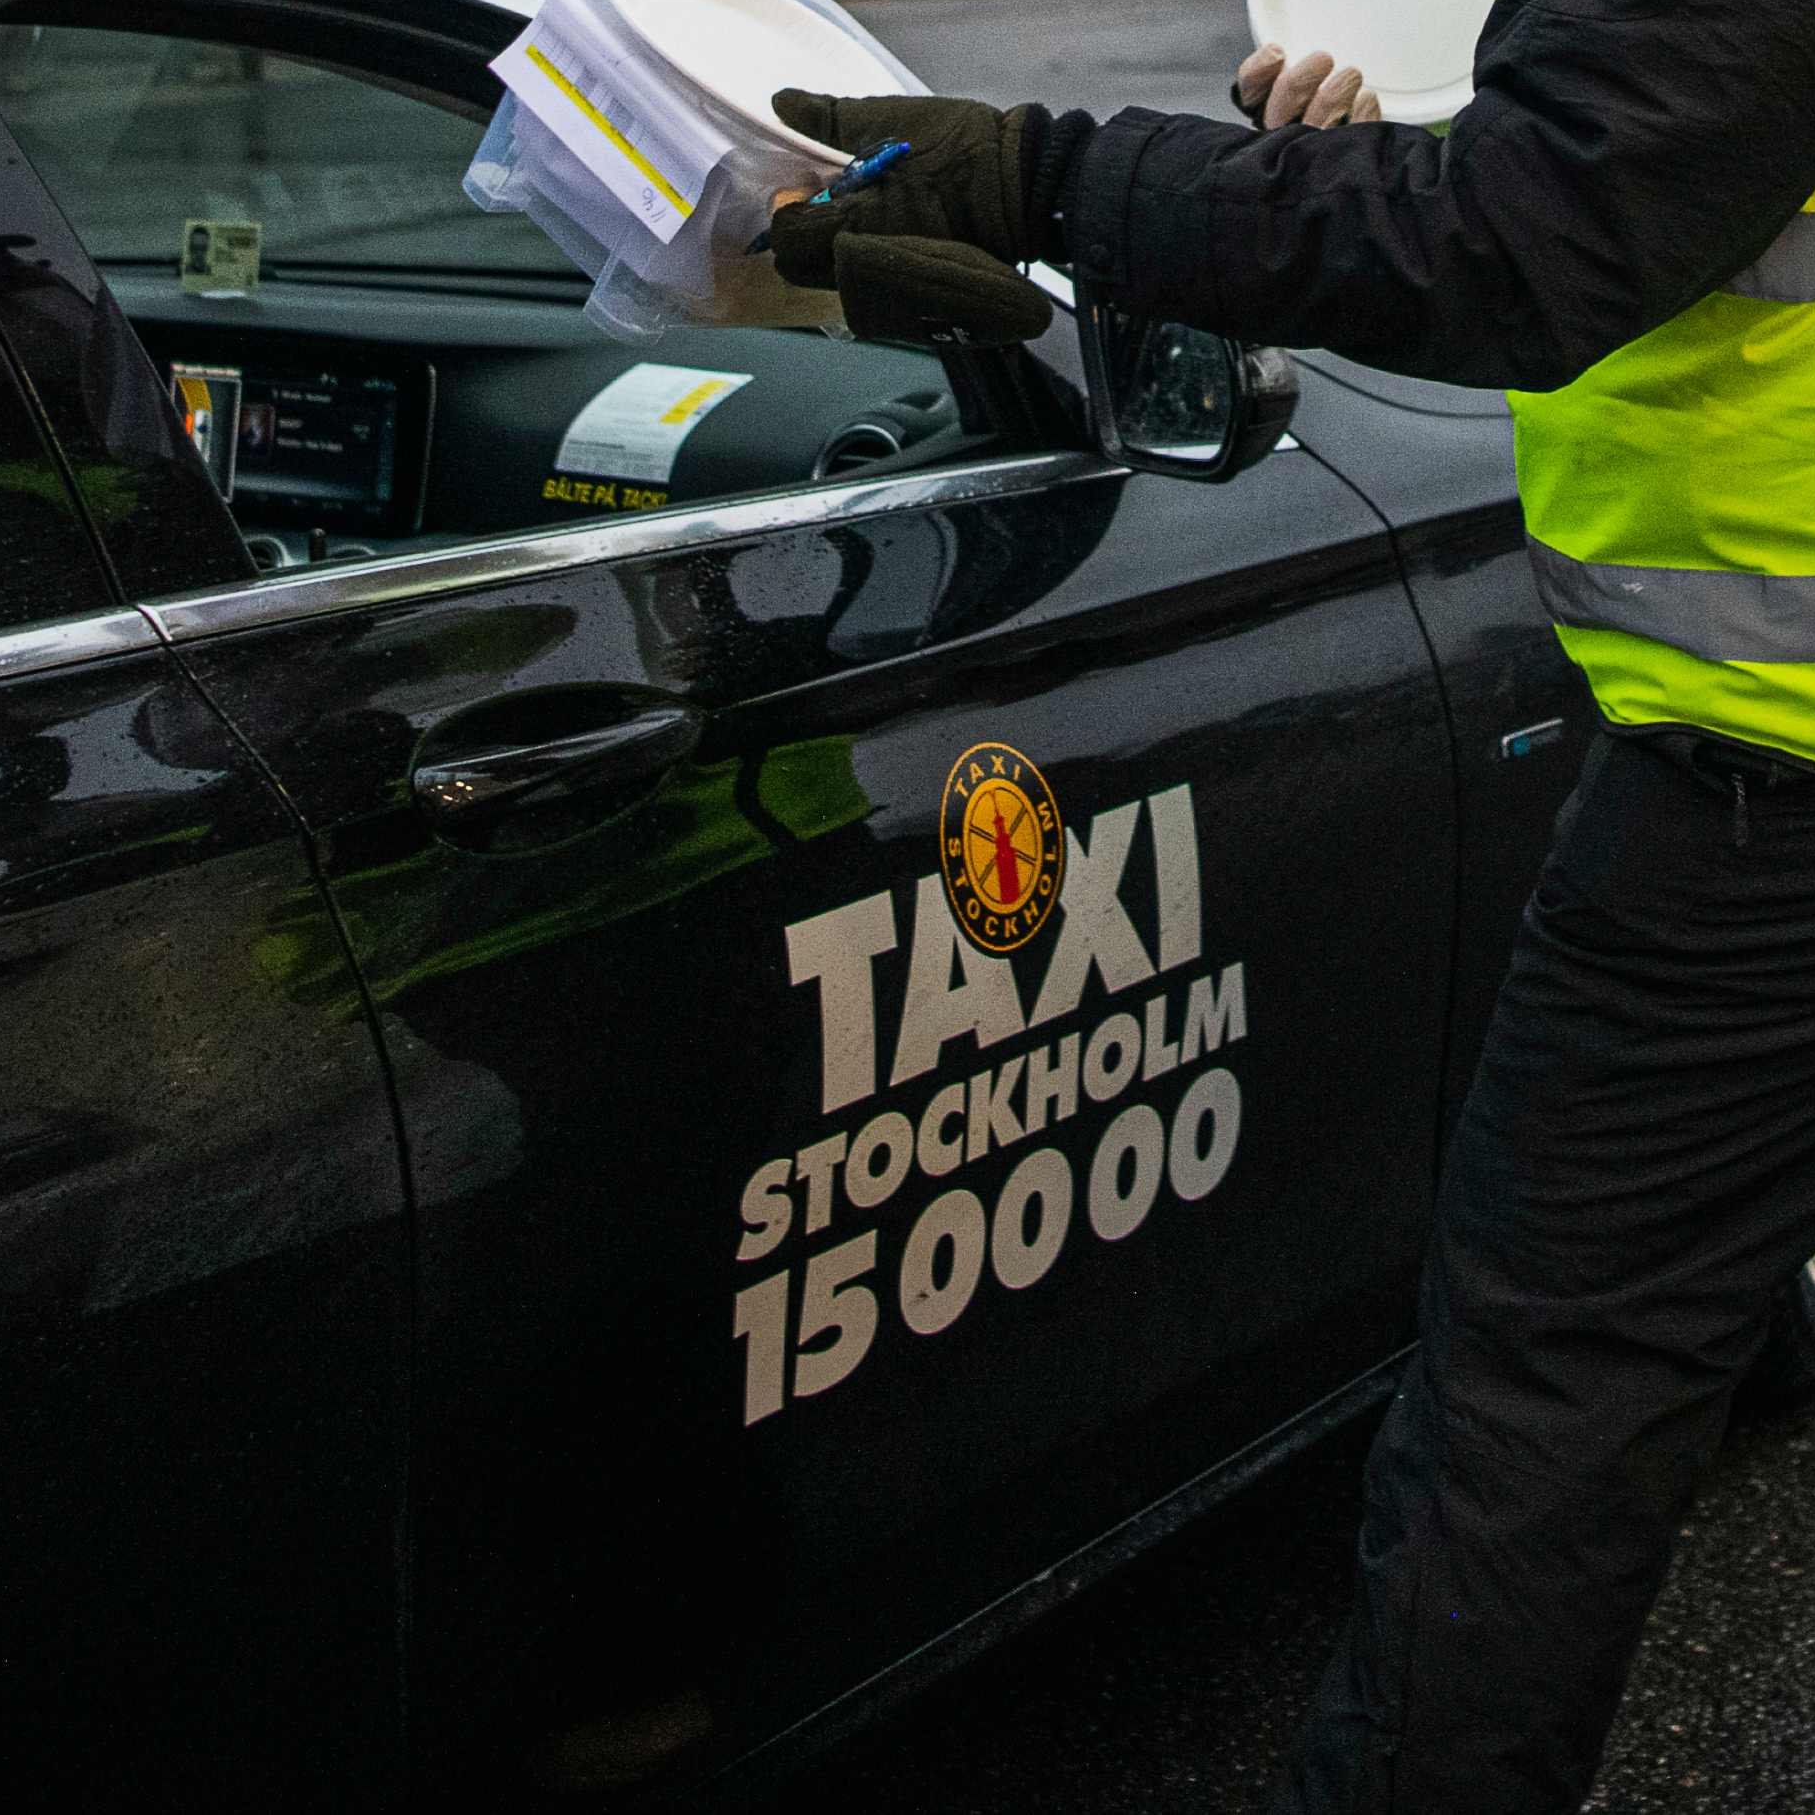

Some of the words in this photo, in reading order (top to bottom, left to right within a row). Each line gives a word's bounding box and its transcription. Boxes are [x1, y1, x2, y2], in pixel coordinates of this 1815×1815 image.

[948, 800, 1057, 939] STOCKHOLM
[954, 755, 1022, 798] TAXI
[785, 783, 1202, 1114] TAXI
[736, 962, 1247, 1261] STOCKHOLM
